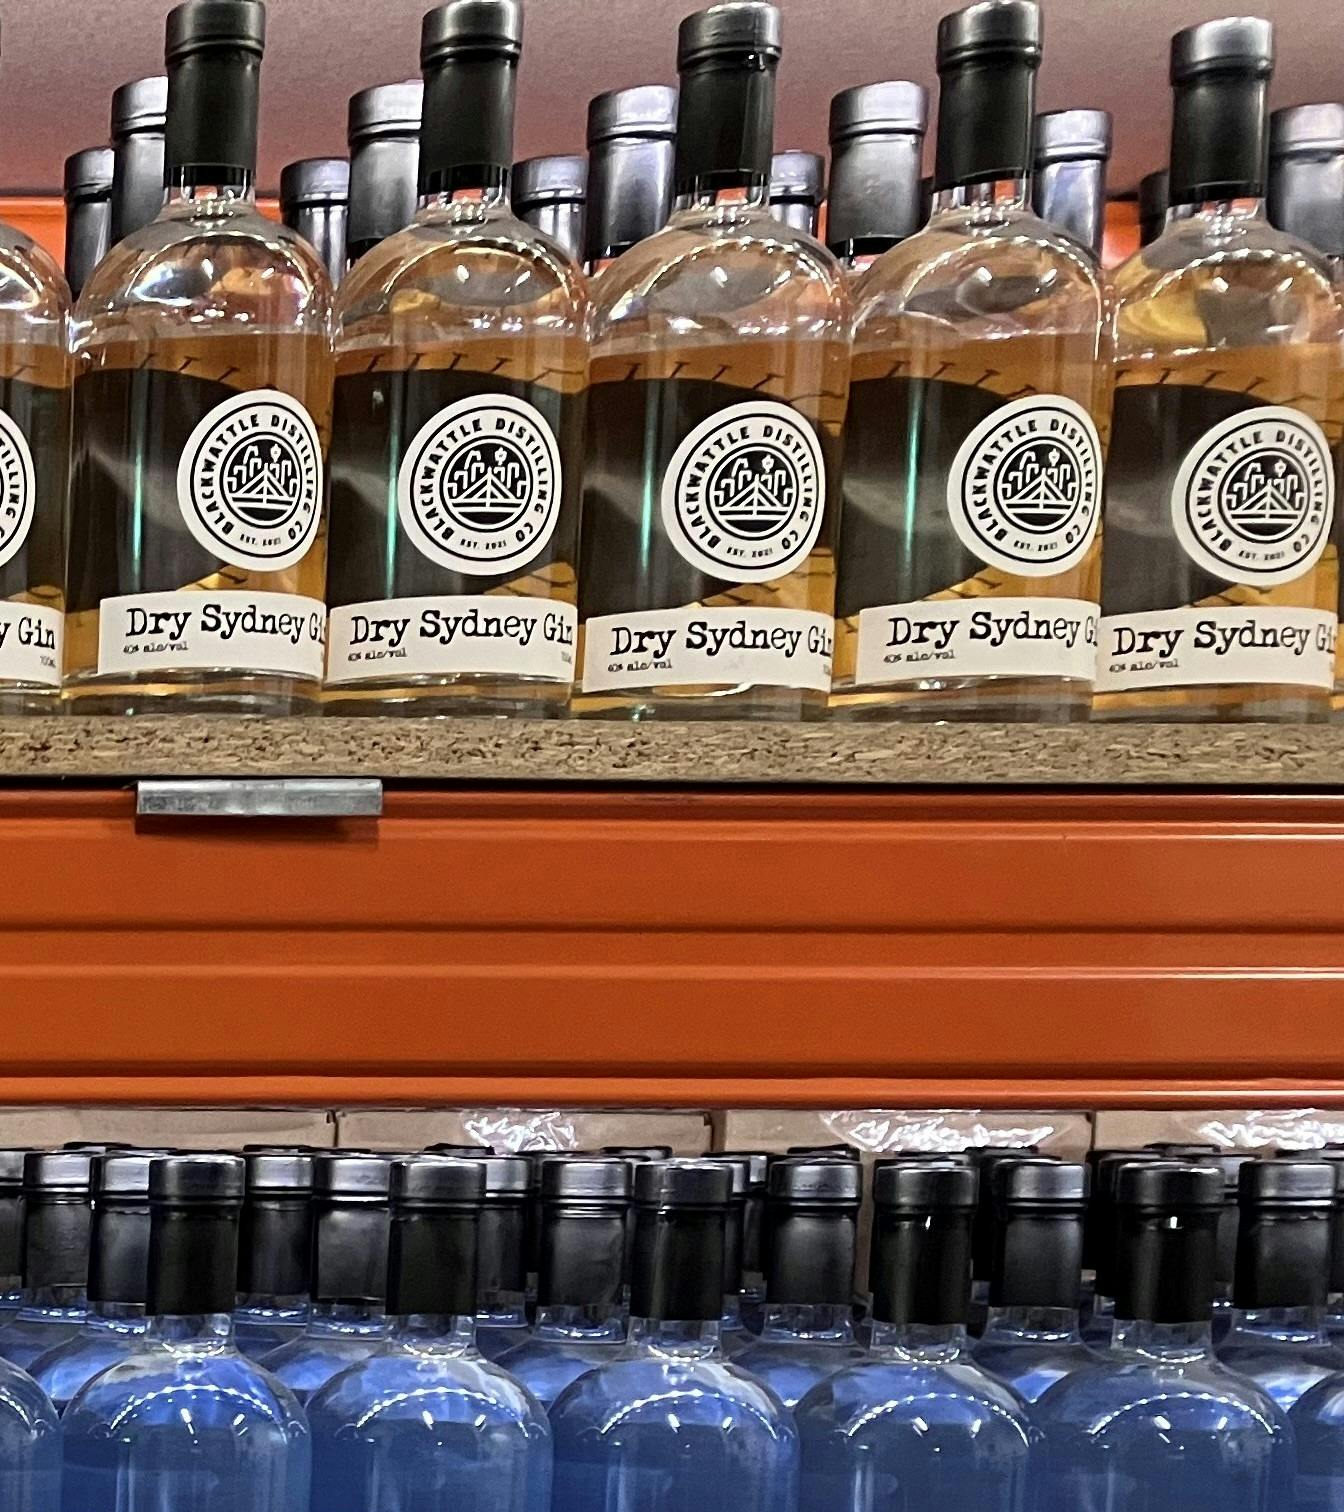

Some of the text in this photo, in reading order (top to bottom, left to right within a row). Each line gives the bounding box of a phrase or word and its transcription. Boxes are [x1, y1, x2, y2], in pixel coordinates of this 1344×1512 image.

[419, 418, 549, 542] BLACKWATTLE DISTILLING CO
[18, 617, 55, 649] Gin
[126, 604, 305, 644] Dry Sydney
[350, 609, 537, 647] Dry Sydney
[610, 620, 802, 659] Dry Sydney
[886, 611, 1081, 649] Dry Sydney
[1112, 620, 1310, 658] Dry Sydney
